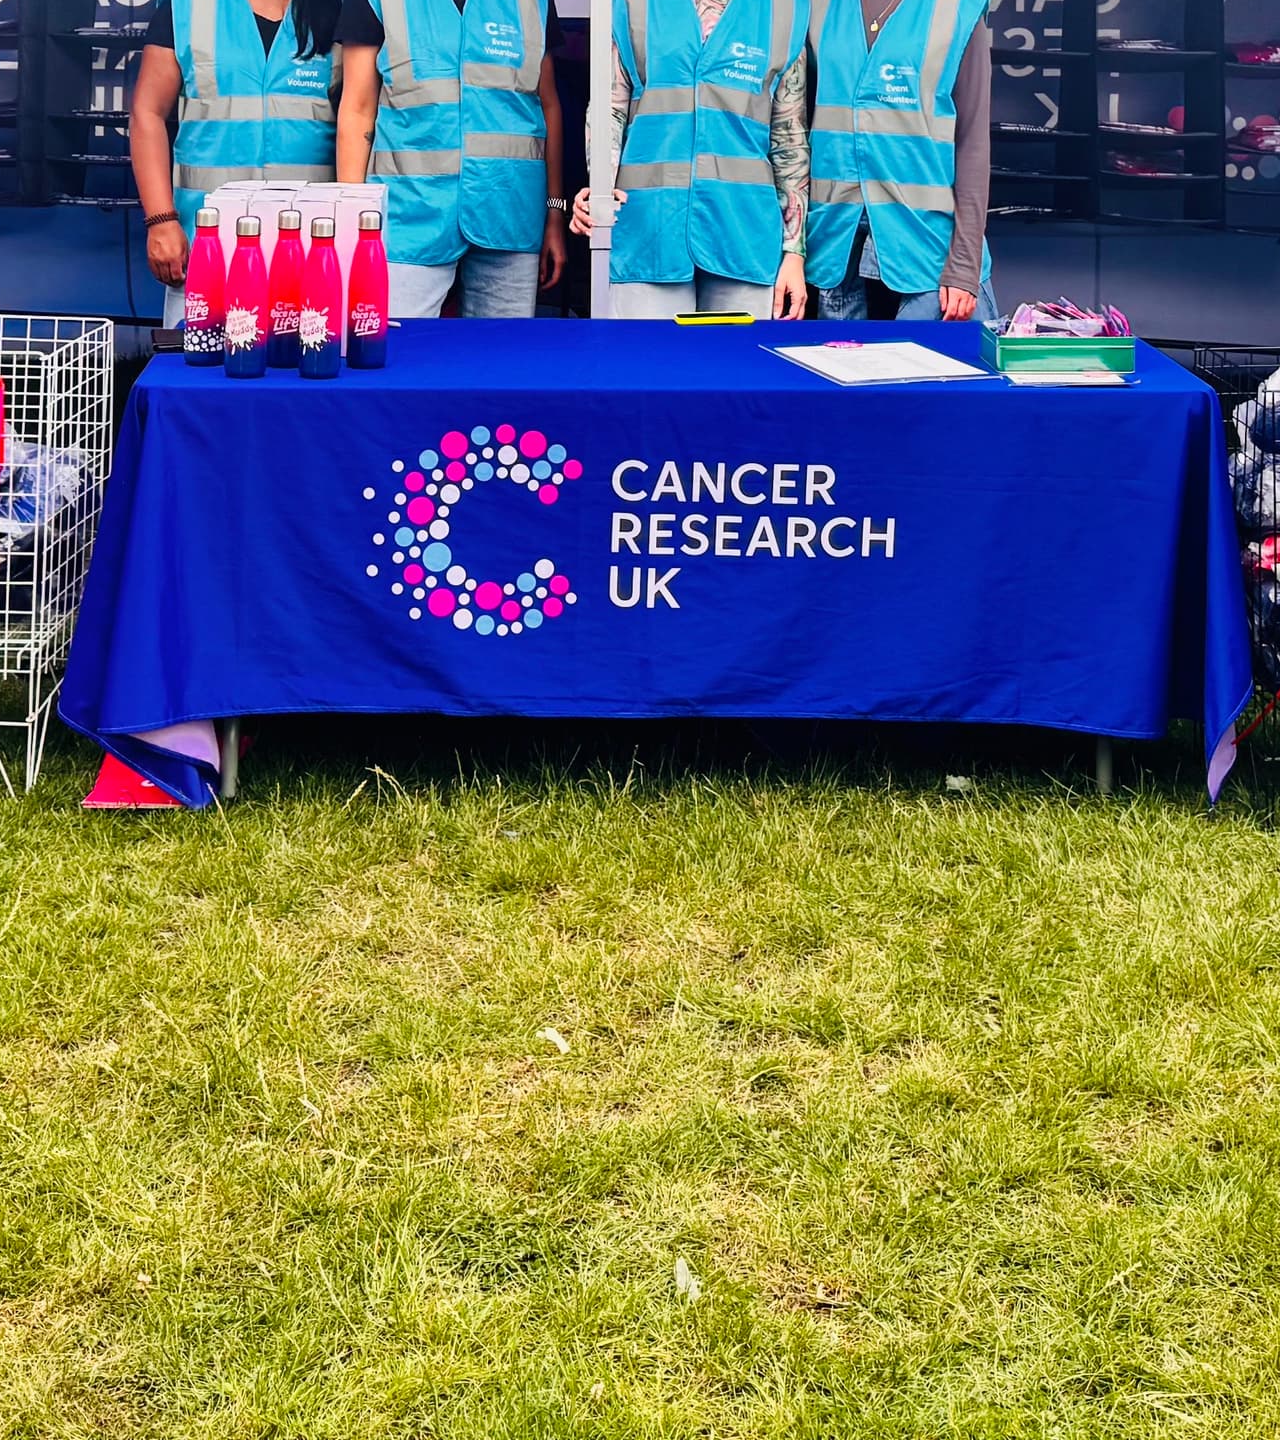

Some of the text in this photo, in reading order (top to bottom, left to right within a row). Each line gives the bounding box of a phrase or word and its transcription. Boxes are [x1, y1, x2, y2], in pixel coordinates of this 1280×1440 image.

[296, 68, 318, 77] Event
[287, 78, 326, 89] Volunteer
[273, 317, 299, 331] Life
[354, 318, 380, 333] Life
[611, 459, 836, 505] CANCER
[611, 512, 896, 558] RESEARCH
[608, 566, 681, 609] UK
